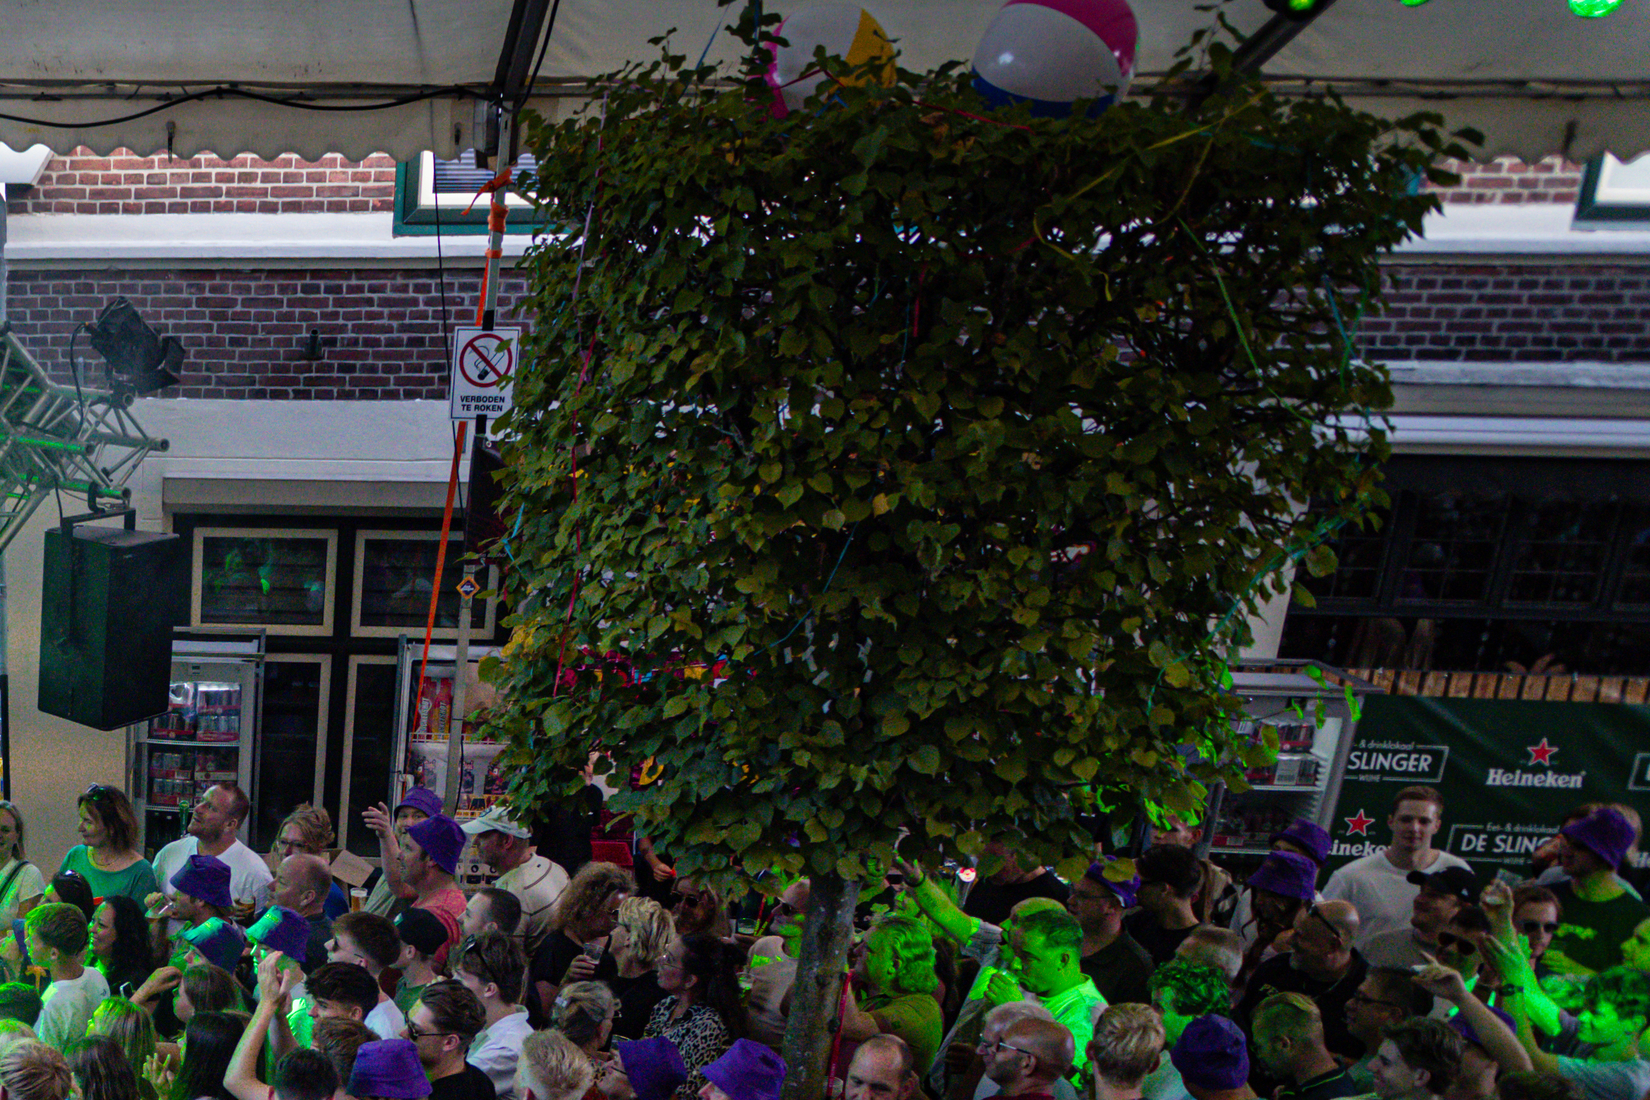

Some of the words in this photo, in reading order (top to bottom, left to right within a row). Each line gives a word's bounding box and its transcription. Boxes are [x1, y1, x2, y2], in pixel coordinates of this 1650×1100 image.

[460, 395, 505, 403] VERBODEN
[461, 404, 471, 412] TE
[474, 404, 503, 412] ROKEN
[1347, 751, 1433, 772] SLINGER
[1485, 767, 1584, 788] Heineken
[1461, 833, 1488, 852] DE
